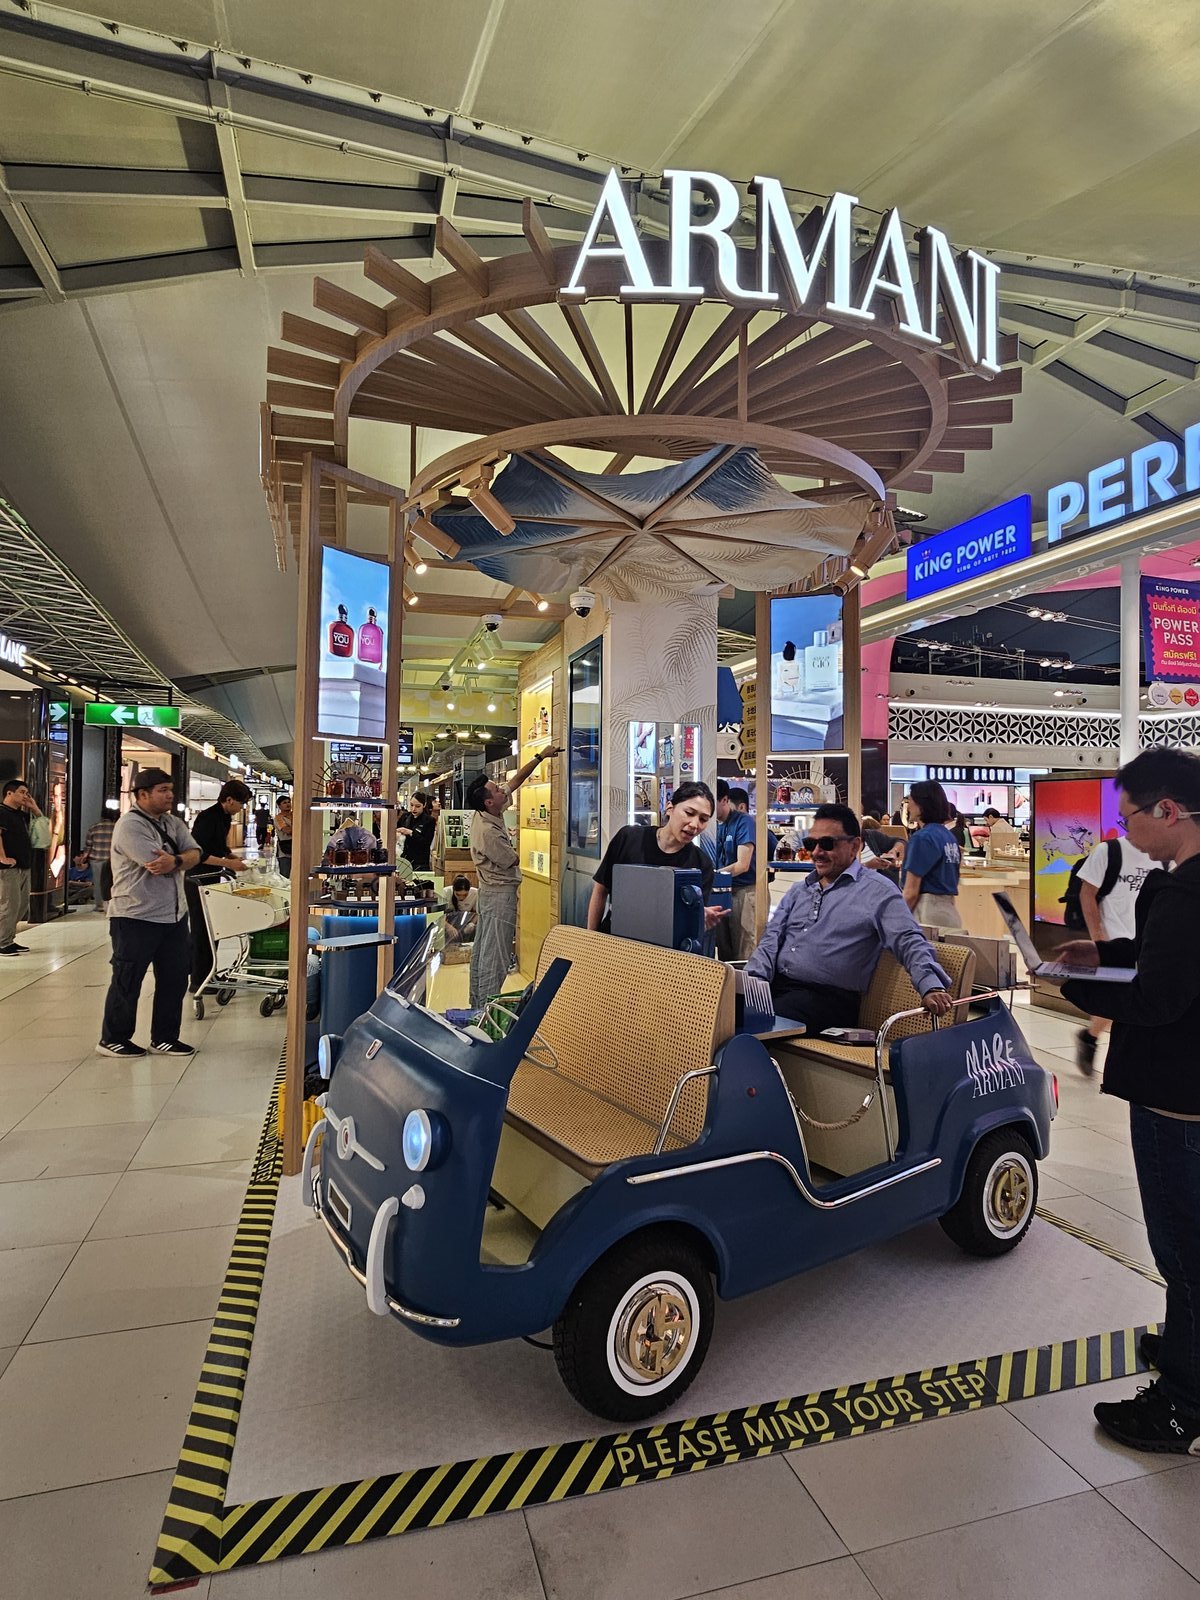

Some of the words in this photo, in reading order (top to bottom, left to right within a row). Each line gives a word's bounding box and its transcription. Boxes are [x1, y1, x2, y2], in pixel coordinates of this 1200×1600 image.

[560, 167, 1001, 372] ARMANI
[915, 551, 953, 581] KING
[956, 524, 1017, 565] POWER
[1155, 585, 1170, 594] KING
[1170, 587, 1190, 595] POWER
[1153, 617, 1200, 634] POWER
[333, 634, 349, 644] YOU
[1163, 632, 1194, 646] PASS
[929, 767, 967, 780] BOBBI
[973, 768, 1013, 781] BROWN
[1118, 875, 1146, 883] NOR
[966, 1033, 1016, 1079] MARE
[972, 1061, 1025, 1098] ARMANI
[614, 1425, 738, 1474] PLEASE
[741, 1407, 830, 1447] MIND
[832, 1388, 922, 1425] YOUR
[921, 1373, 986, 1406] STEP
